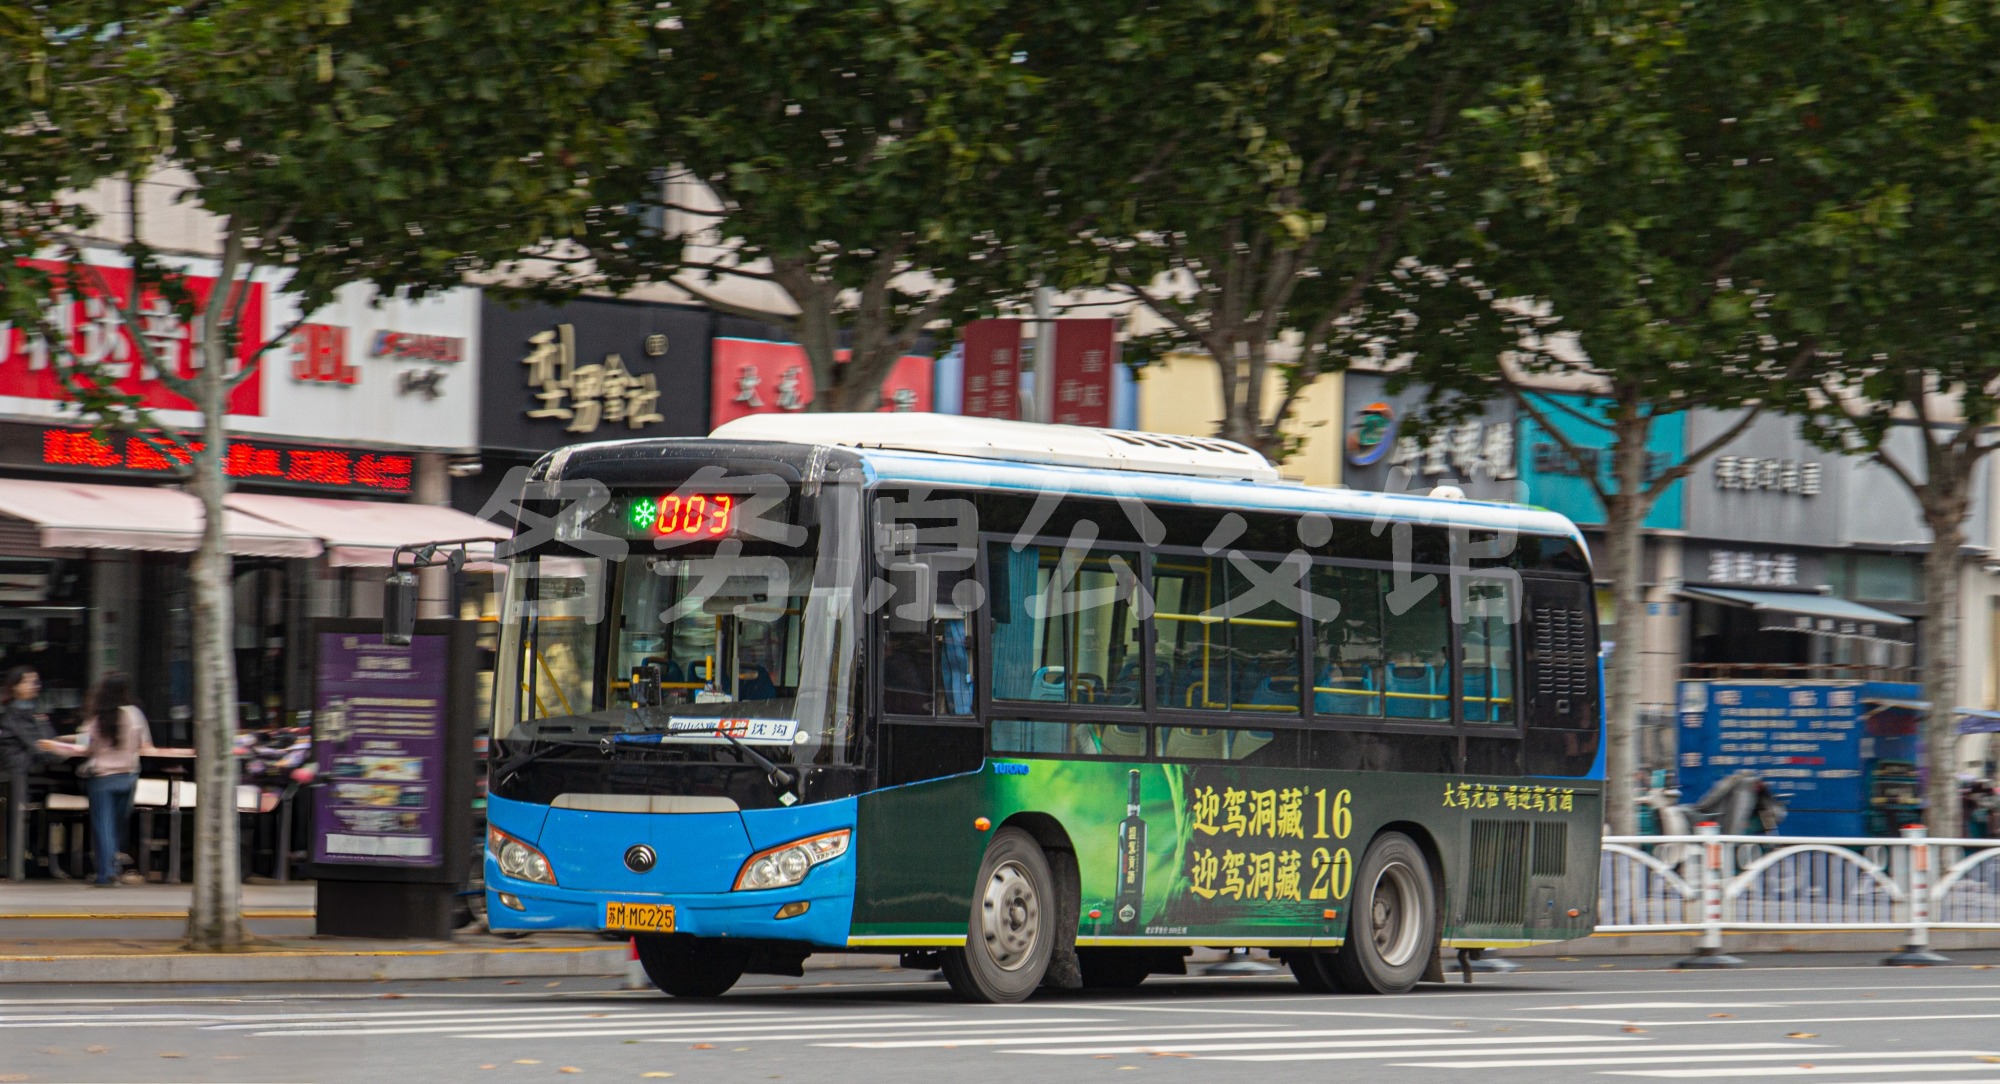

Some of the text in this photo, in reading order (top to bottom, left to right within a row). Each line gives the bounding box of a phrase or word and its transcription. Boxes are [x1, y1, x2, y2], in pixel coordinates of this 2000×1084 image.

[657, 495, 732, 534] 003
[992, 762, 1030, 775] YUTONG
[1192, 785, 1353, 840] 迎驾洞藏 16
[1190, 848, 1302, 903] 迎驾洞藏
[1308, 847, 1353, 900] 20
